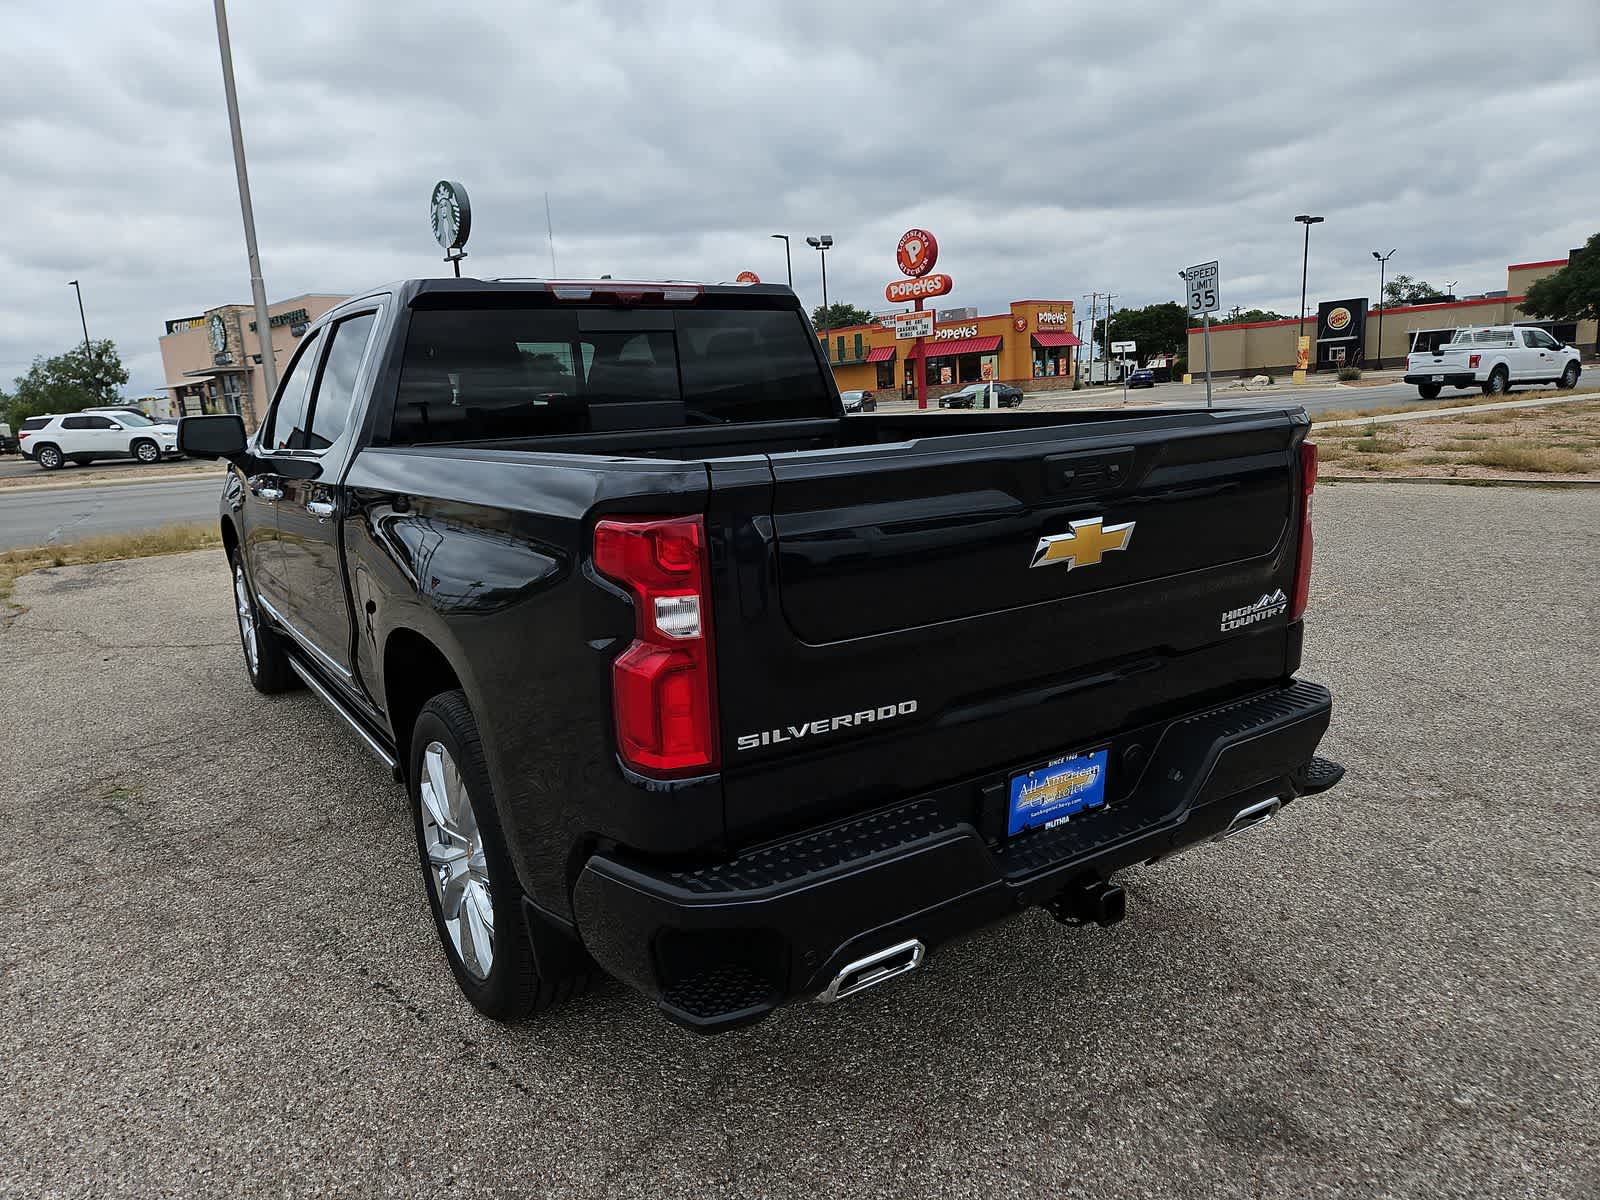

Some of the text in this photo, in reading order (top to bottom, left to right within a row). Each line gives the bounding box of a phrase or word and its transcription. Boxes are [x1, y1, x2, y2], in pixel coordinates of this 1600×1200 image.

[897, 230, 929, 252] LOUISIANA
[899, 257, 929, 275] KITCHEN
[1187, 266, 1217, 281] SPEED
[889, 277, 942, 299] POPEYES
[1191, 278, 1213, 292] LIMIT
[1191, 290, 1216, 310] 35
[1038, 311, 1068, 324] POPEYES
[934, 325, 978, 341] POPEYES
[1220, 603, 1287, 632] COUNTRY
[1222, 604, 1258, 623] HIGH
[737, 700, 917, 751] SILVERADO
[1047, 756, 1065, 768] SINCE
[1018, 764, 1100, 798] All American
[1029, 780, 1085, 808] Chevrolet
